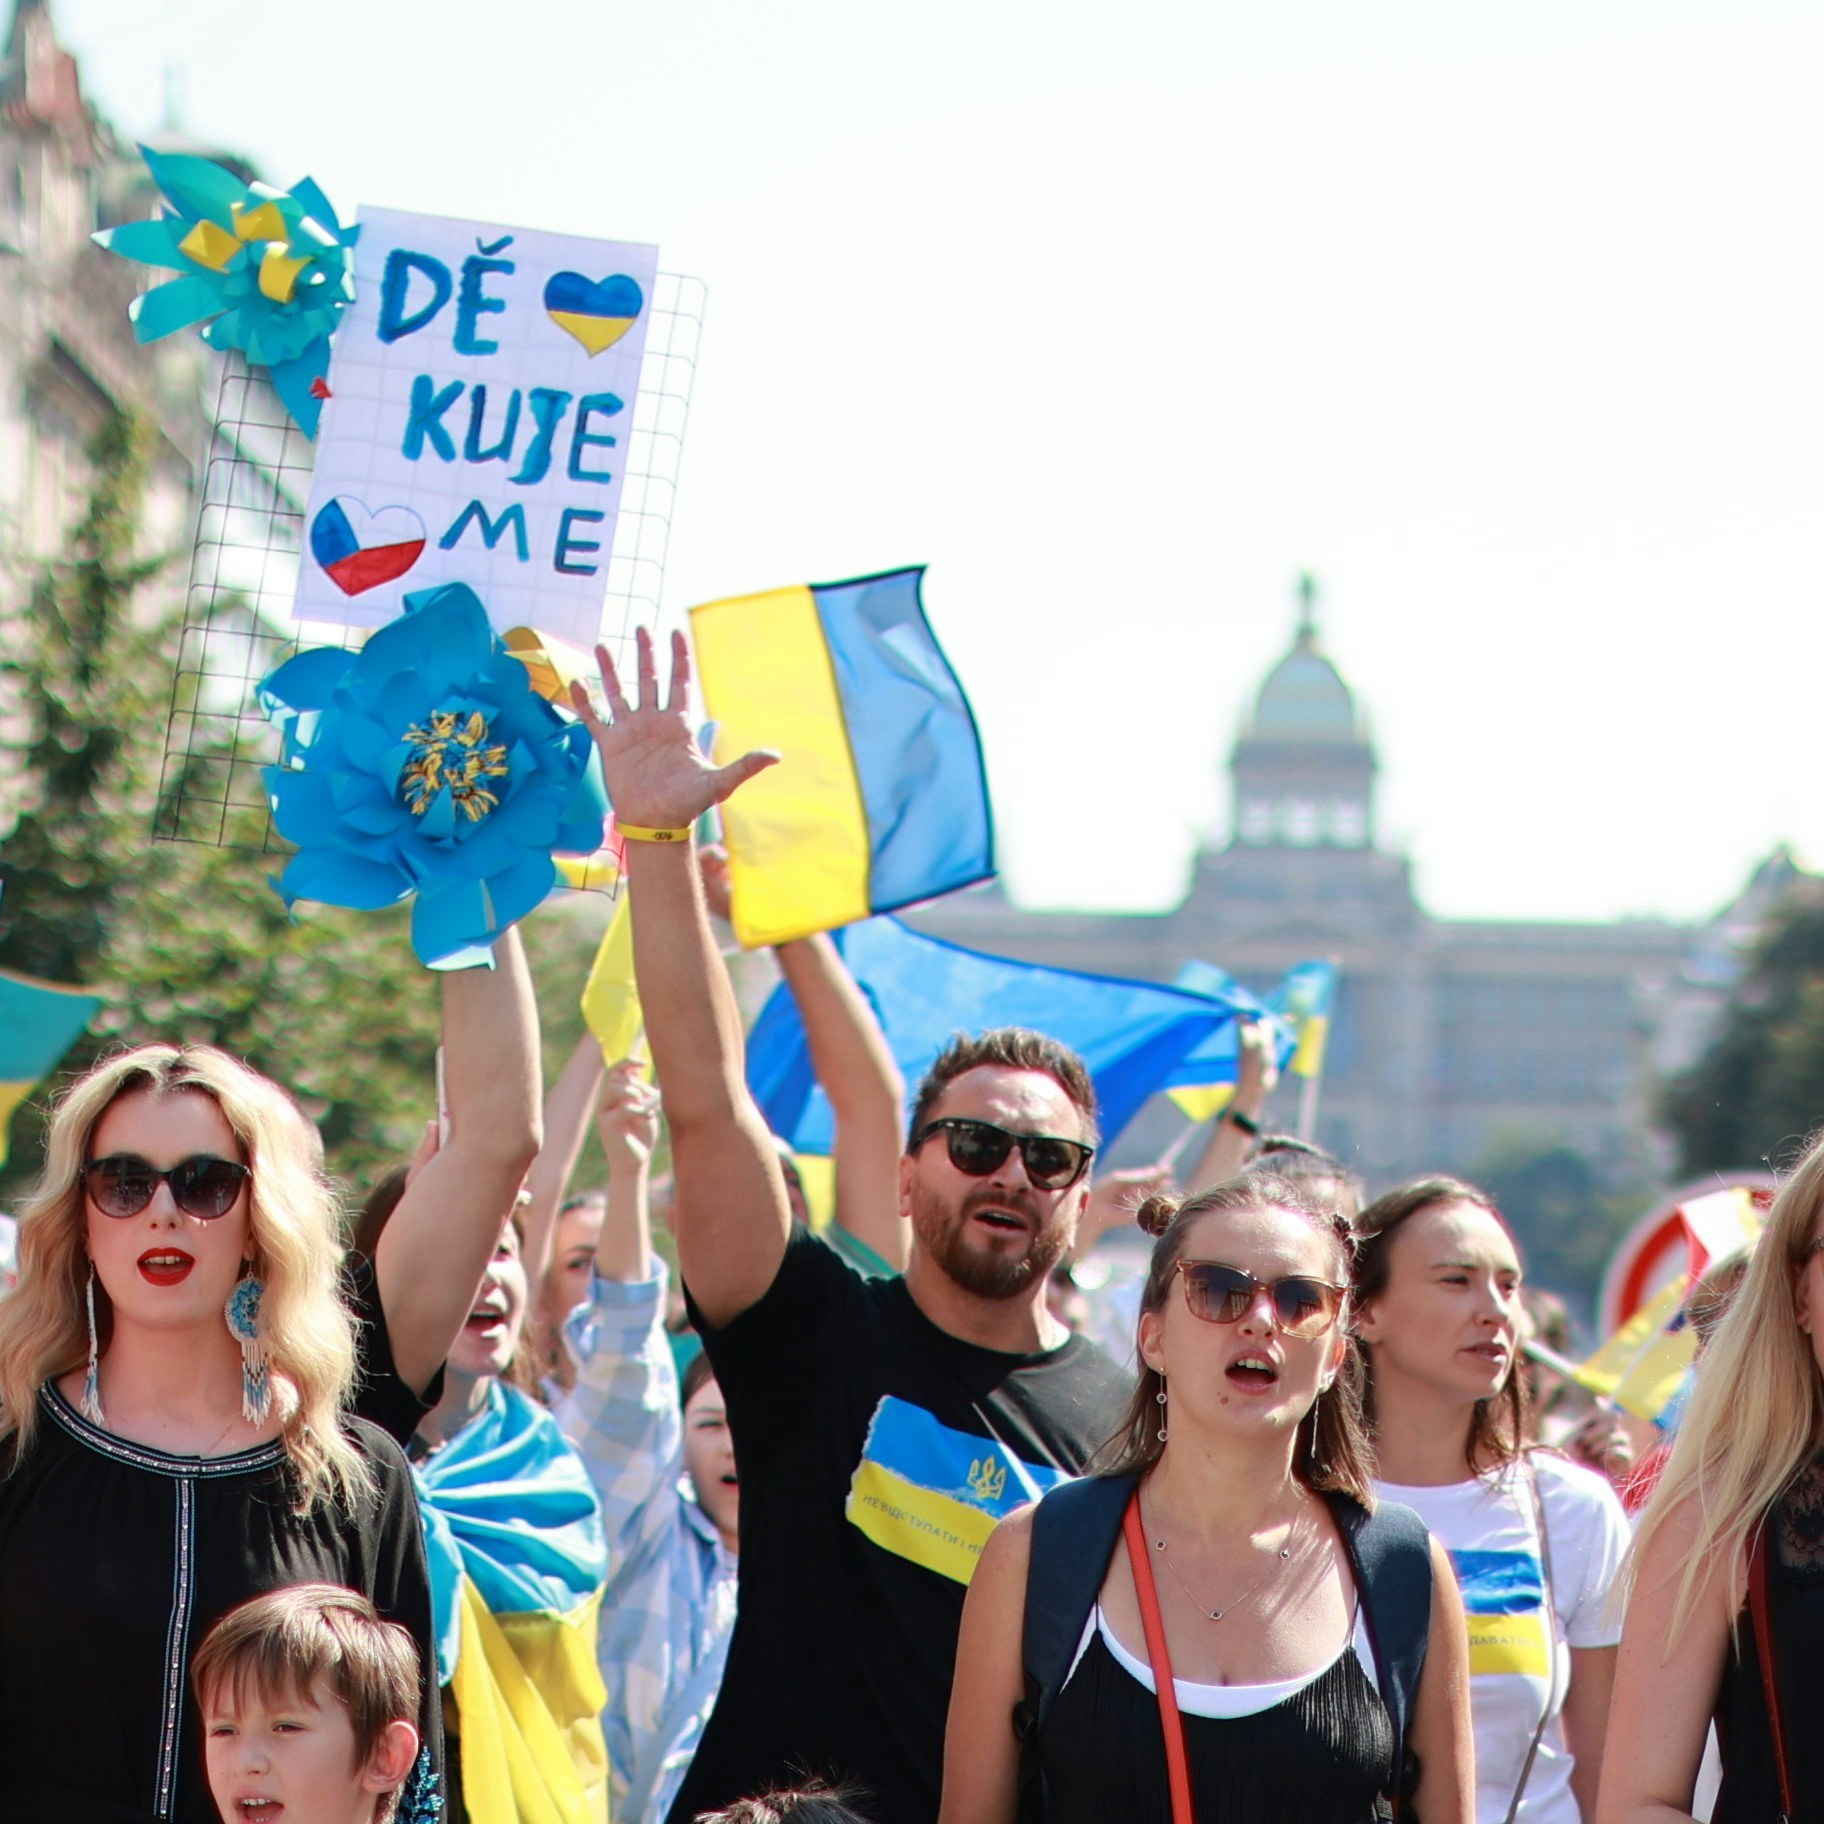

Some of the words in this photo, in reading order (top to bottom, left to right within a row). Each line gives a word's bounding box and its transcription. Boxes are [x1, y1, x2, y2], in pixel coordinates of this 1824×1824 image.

[377, 236, 516, 357] DĚ
[401, 374, 624, 486] KUJE
[439, 499, 606, 577] ME
